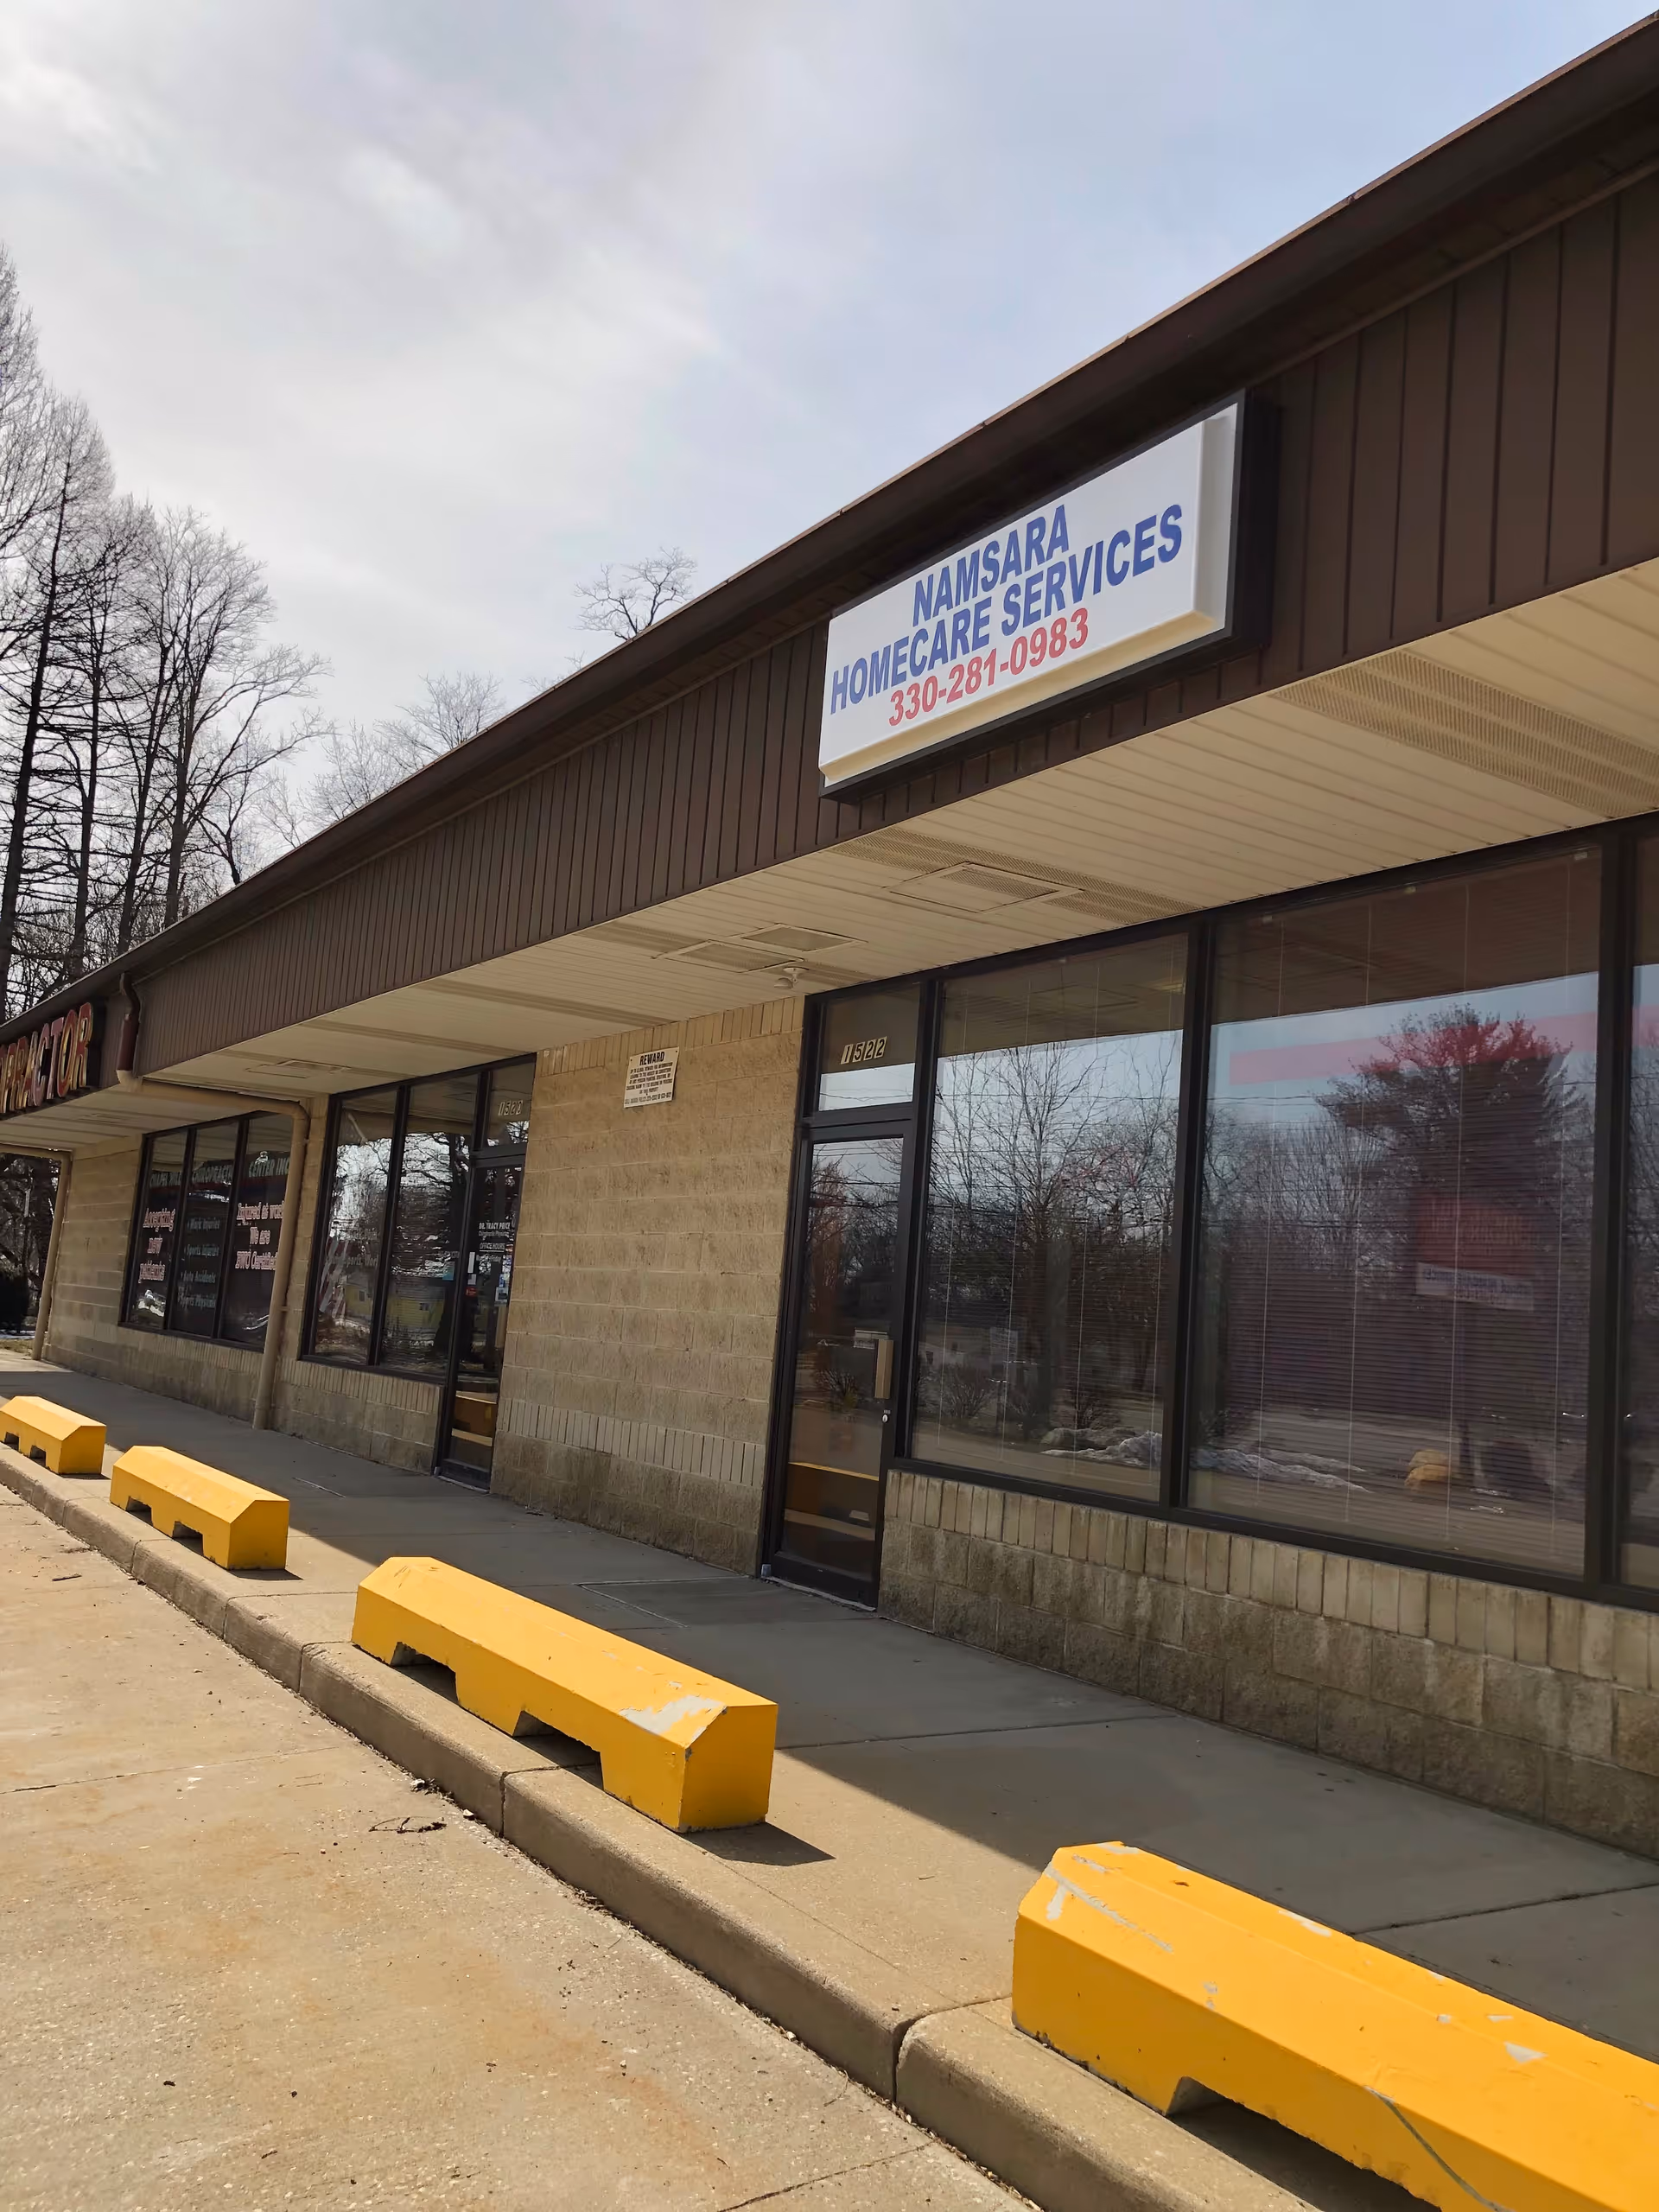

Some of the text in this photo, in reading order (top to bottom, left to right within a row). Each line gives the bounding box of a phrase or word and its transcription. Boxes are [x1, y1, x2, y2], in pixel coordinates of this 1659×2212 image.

[912, 504, 1070, 626] NAMSARA
[830, 504, 1183, 715] HOMECARE SERVICES
[888, 607, 1089, 727] 330-281-0983
[639, 1051, 665, 1065] REWARD
[843, 1037, 887, 1064] 1522
[248, 1160, 274, 1178] CENTER
[143, 1208, 175, 1232] Accepting
[236, 1201, 261, 1223] Injured
[250, 1226, 259, 1244] We
